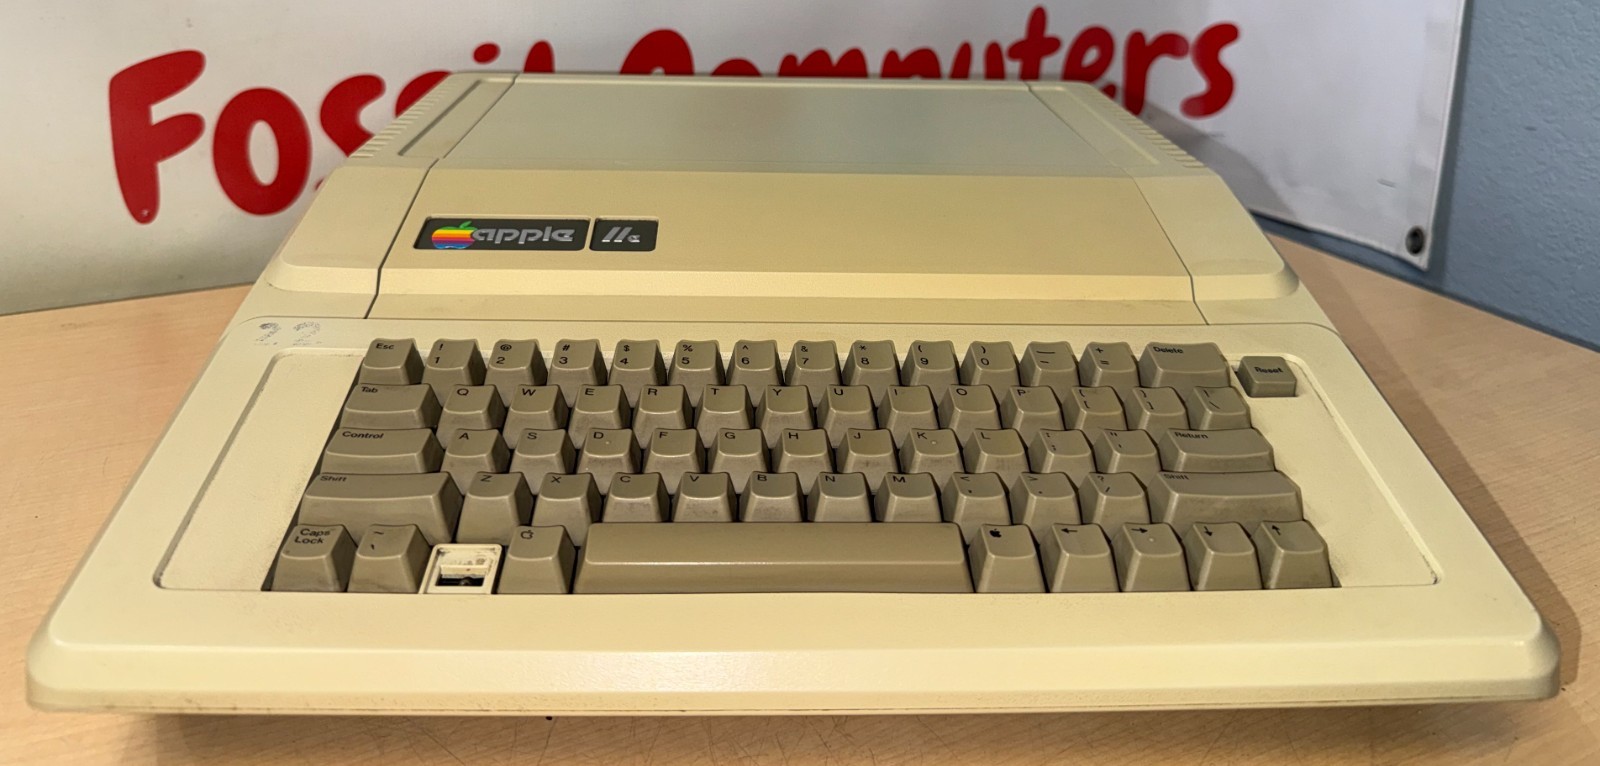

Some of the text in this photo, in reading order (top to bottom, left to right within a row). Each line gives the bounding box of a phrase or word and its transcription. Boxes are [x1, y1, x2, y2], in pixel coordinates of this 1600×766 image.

[472, 226, 576, 245] apple
[375, 342, 395, 350] Esc
[1152, 346, 1184, 354] Delete
[495, 356, 506, 365] 2
[558, 356, 569, 365] 3
[619, 357, 629, 365] 4
[681, 356, 690, 365] 5
[741, 356, 750, 365] 6
[801, 357, 810, 365] 7
[860, 357, 870, 366] 8
[919, 357, 929, 366] 9
[1253, 366, 1284, 374] Reset
[361, 386, 379, 394] Tab
[456, 387, 470, 397] Q
[521, 387, 537, 397] W
[584, 387, 595, 396] E
[647, 387, 658, 396] R
[710, 387, 720, 396] T
[772, 388, 782, 397] Y
[833, 387, 844, 396] U
[955, 387, 968, 396] O
[1016, 388, 1027, 397] P
[341, 430, 385, 439] Control
[458, 432, 470, 441] A
[526, 431, 538, 440] S
[593, 431, 605, 440] D
[658, 431, 668, 439] F
[724, 431, 736, 440] G
[788, 431, 799, 440] H
[853, 431, 862, 440] J
[916, 431, 928, 440] K
[980, 431, 991, 440] L
[1173, 431, 1209, 439] Return
[319, 473, 349, 482] Shift
[480, 474, 493, 483] Z
[550, 475, 562, 484] X
[619, 475, 632, 483] C
[689, 474, 700, 483] V
[756, 473, 768, 482] B
[824, 474, 836, 483] N
[892, 473, 908, 484] M
[299, 527, 331, 538] Caps
[293, 536, 325, 545] Lock
